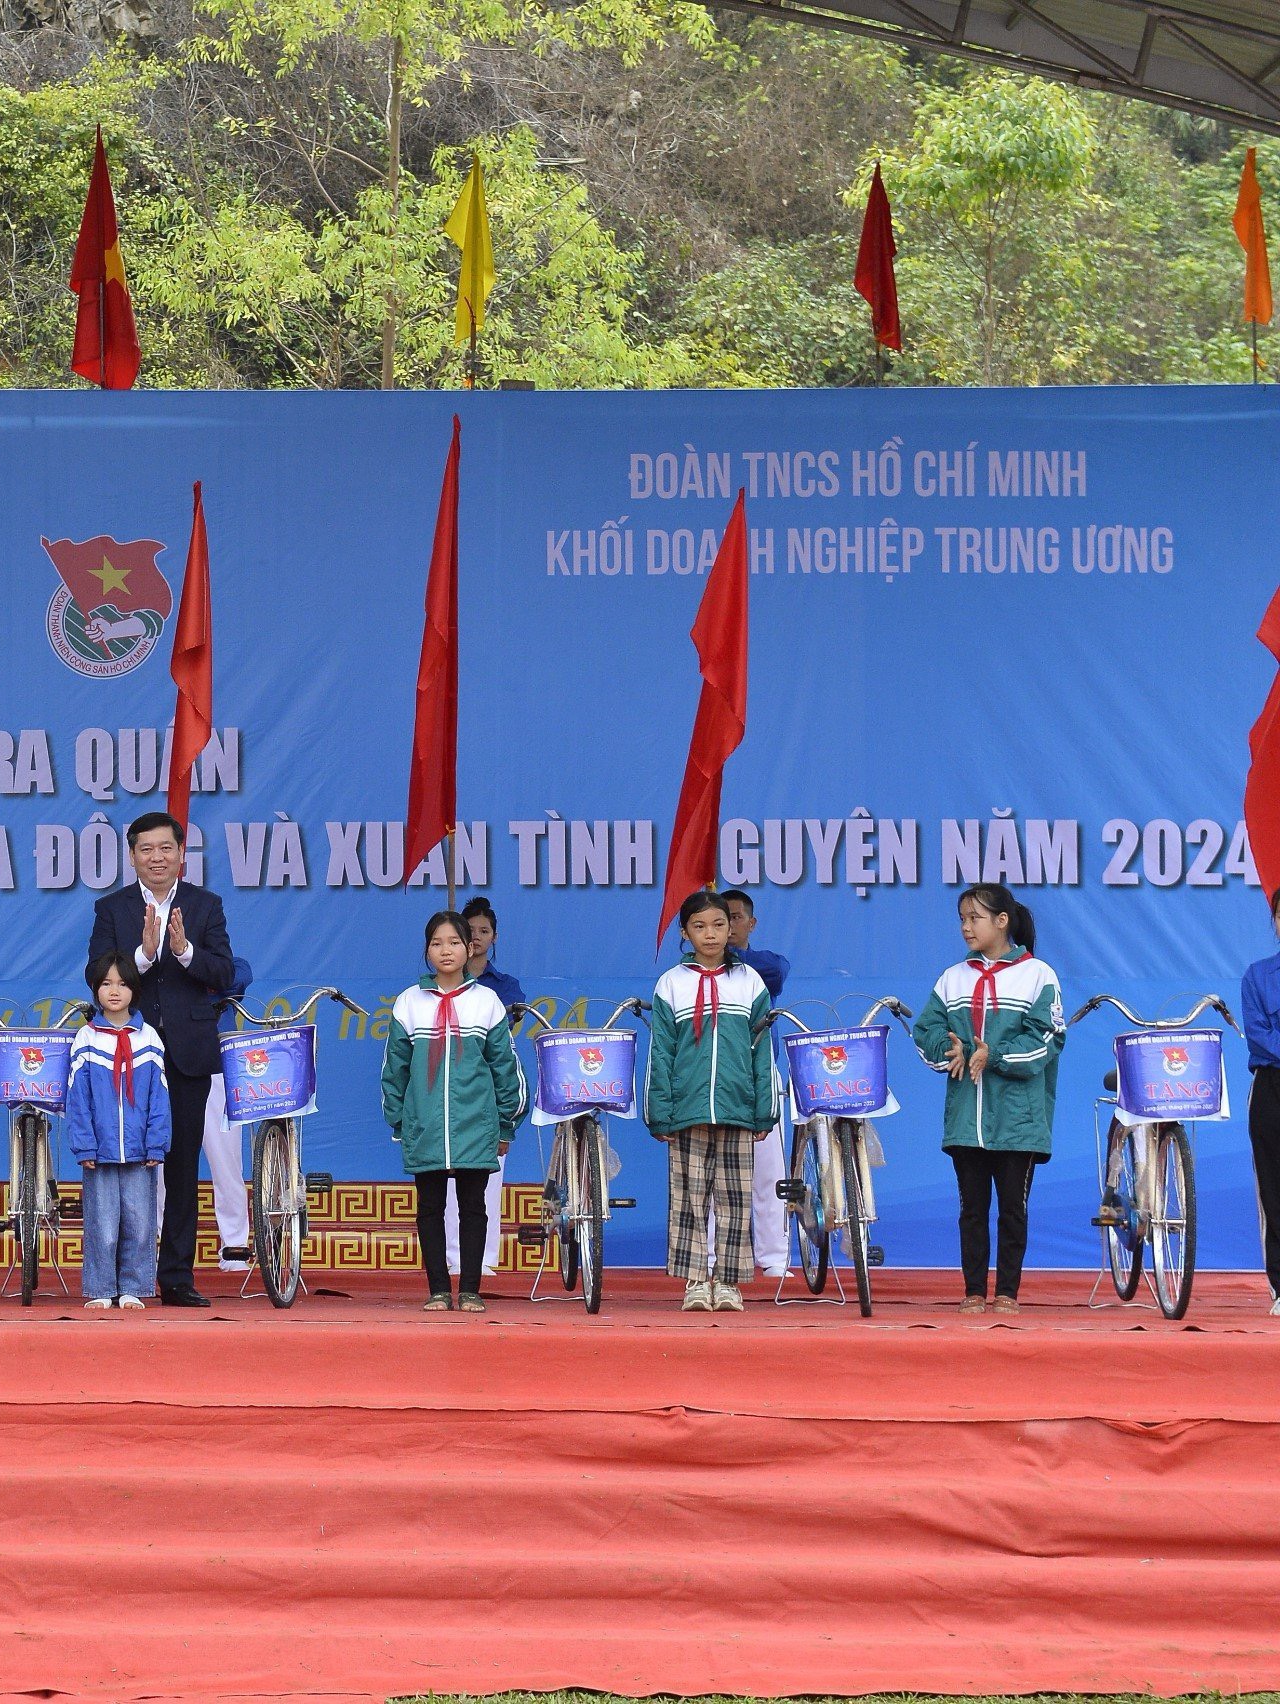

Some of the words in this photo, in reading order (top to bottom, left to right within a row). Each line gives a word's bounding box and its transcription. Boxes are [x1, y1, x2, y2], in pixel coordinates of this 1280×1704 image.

[629, 444, 731, 499] ĐOÀN
[743, 451, 840, 498] TNCS
[852, 437, 903, 497] HỒ
[914, 442, 977, 497] CHÍ
[989, 451, 1086, 497] MINH
[547, 516, 634, 576] KHỐI
[646, 529, 775, 575] DOAH
[787, 517, 924, 583] NGHIỆP
[935, 528, 1060, 574] TRUNG
[1072, 525, 1174, 574] ƯƠNG
[51, 613, 61, 640] THANH
[134, 640, 151, 661] MINH
[33, 812, 203, 890] ĐÔ
[224, 811, 308, 887] VÀ
[509, 810, 653, 885] TÌNH
[720, 806, 917, 897] GUYỆN
[942, 807, 1079, 885] NĂM
[1102, 818, 1262, 886] 2024
[338, 996, 396, 1040] nă
